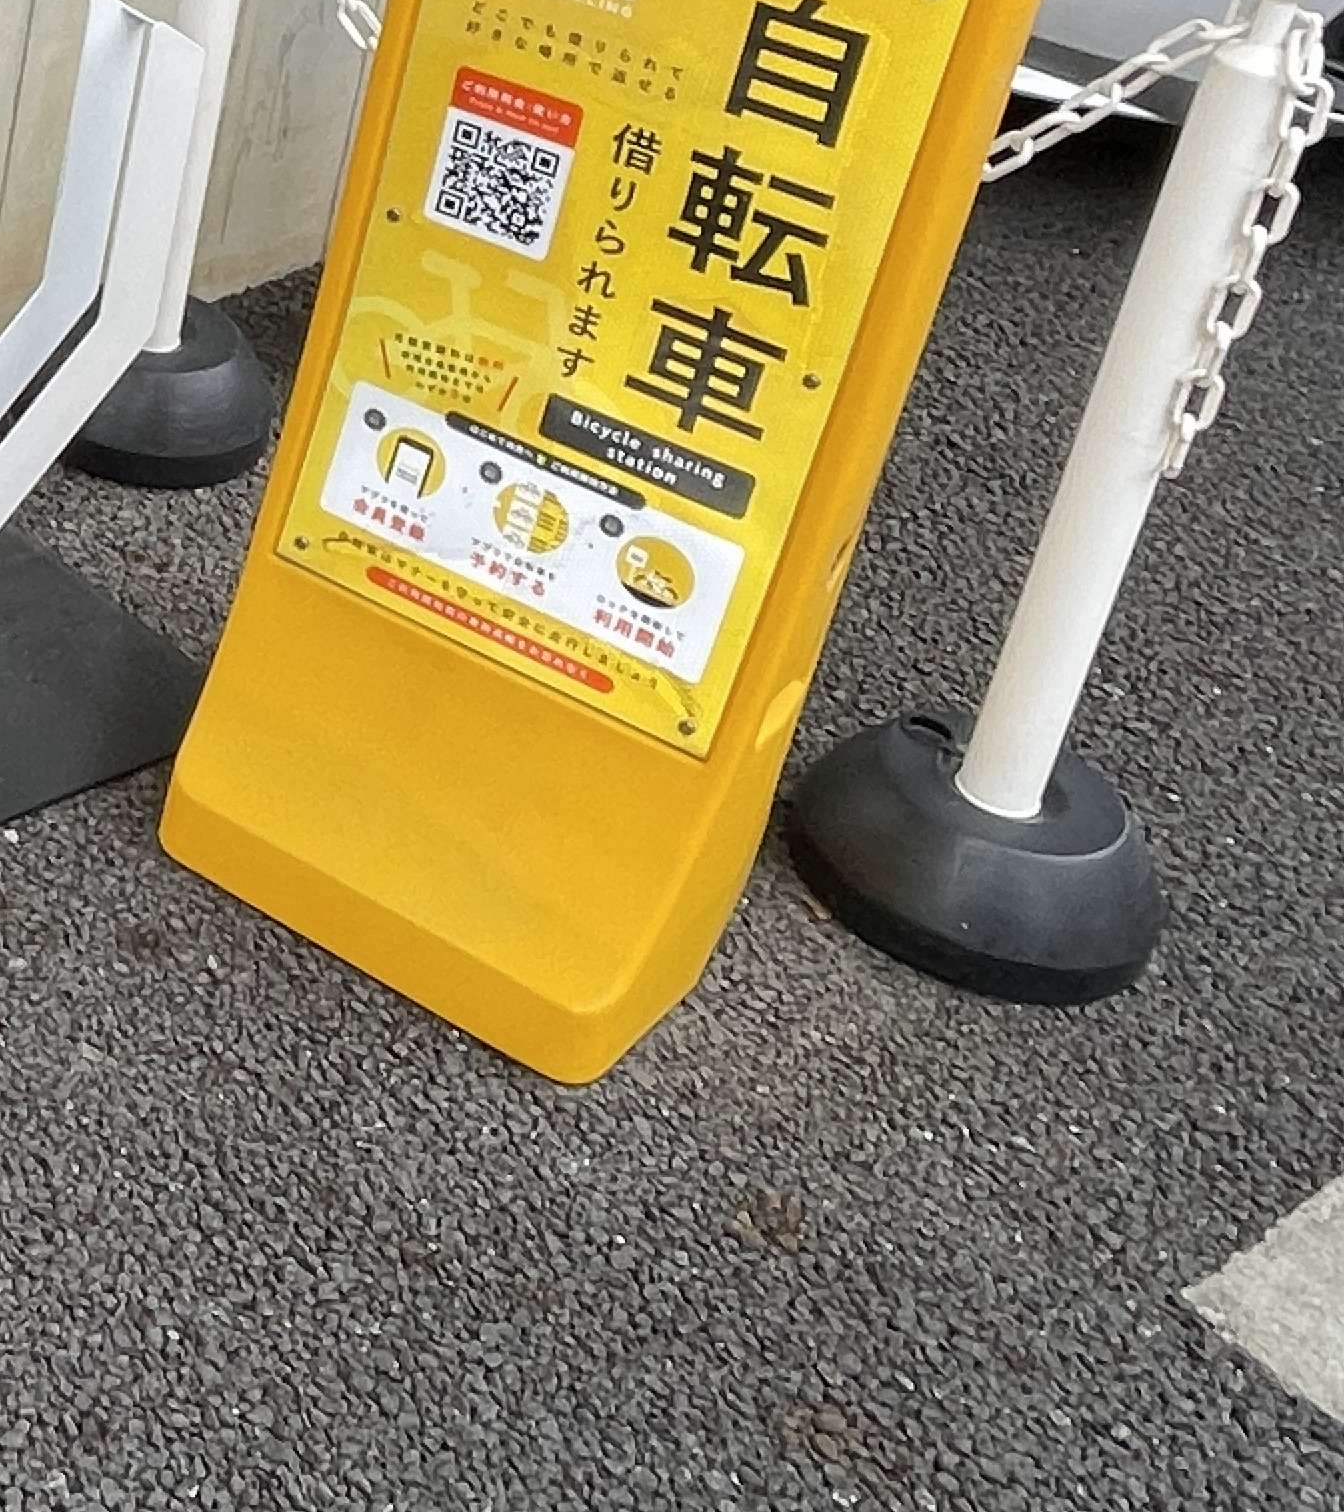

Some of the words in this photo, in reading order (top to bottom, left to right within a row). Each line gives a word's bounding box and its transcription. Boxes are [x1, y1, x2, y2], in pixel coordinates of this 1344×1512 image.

[557, 123, 663, 379] 借りられます
[570, 410, 643, 452] Bicycle
[652, 442, 727, 489] sharing
[606, 446, 679, 486] station
